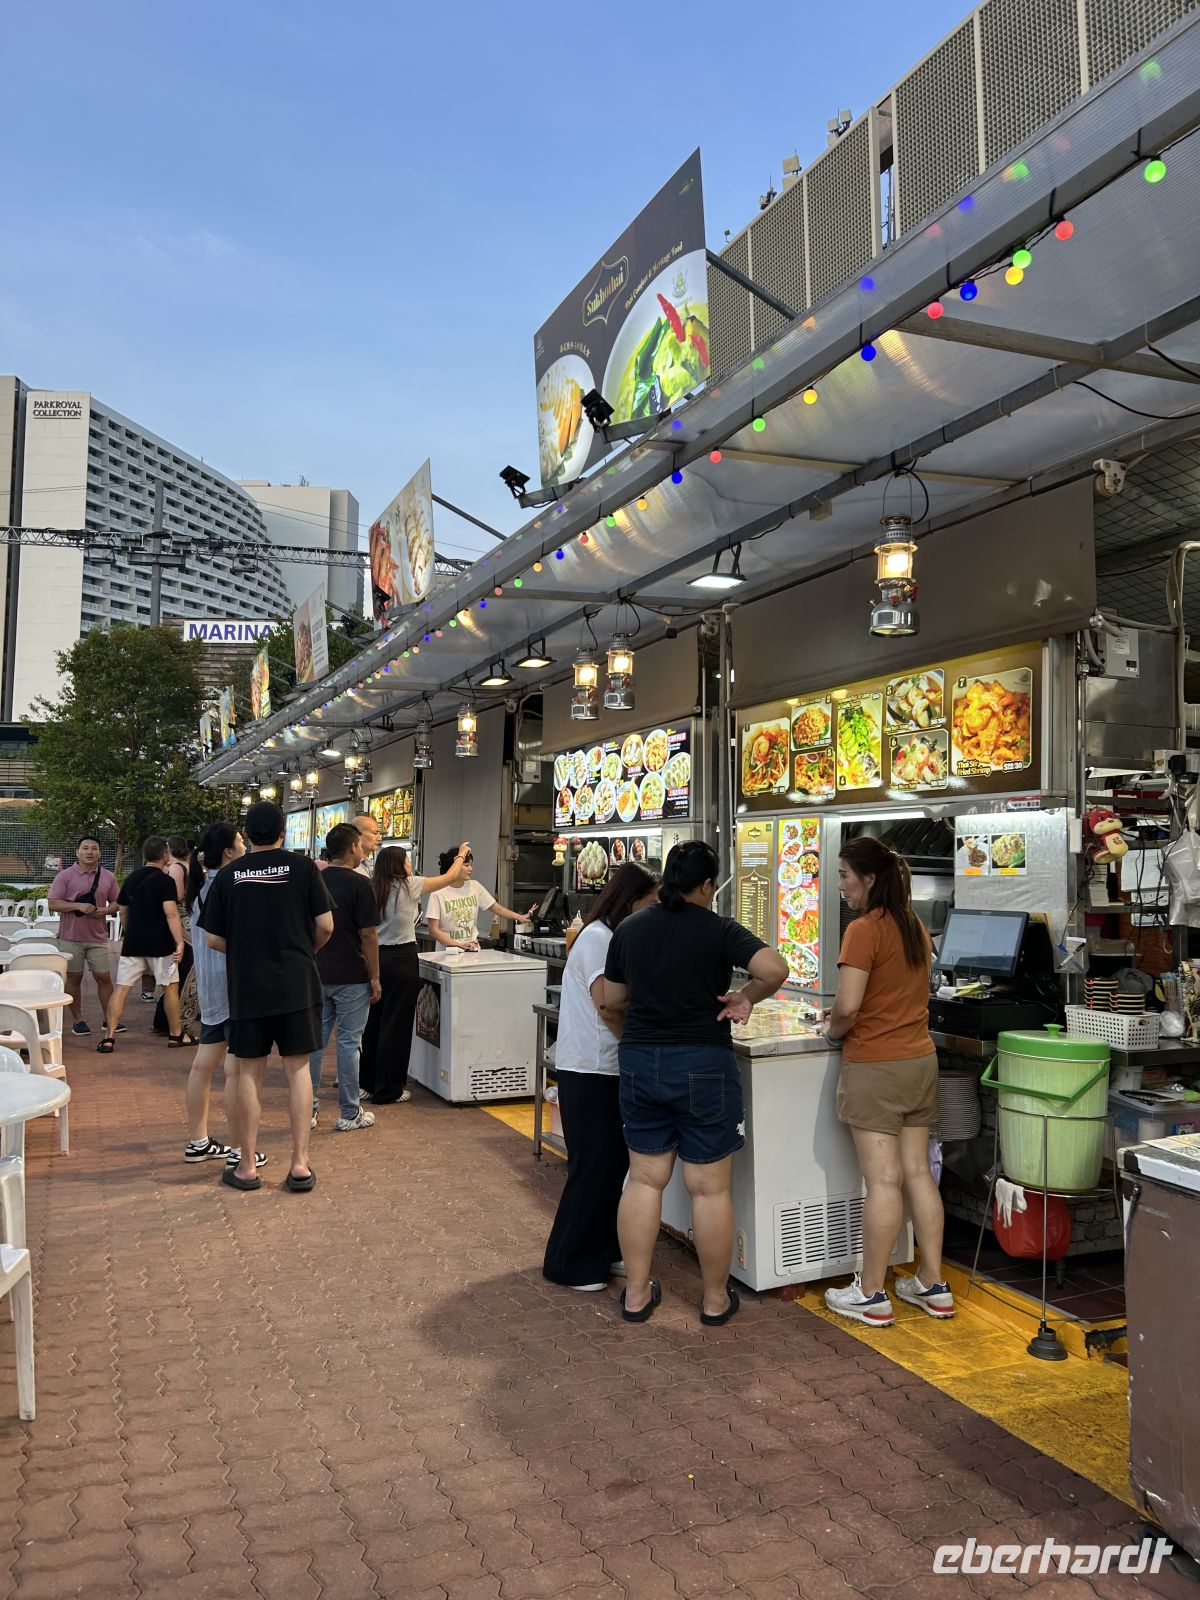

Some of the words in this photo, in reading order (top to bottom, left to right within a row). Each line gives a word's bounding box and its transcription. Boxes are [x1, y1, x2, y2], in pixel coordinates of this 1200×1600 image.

[586, 266, 624, 316] Sukhothai
[34, 401, 82, 409] PARKROYAL
[233, 864, 290, 880] Balenciaga
[445, 895, 477, 913] DZUKOU
[449, 926, 474, 940] VALLY
